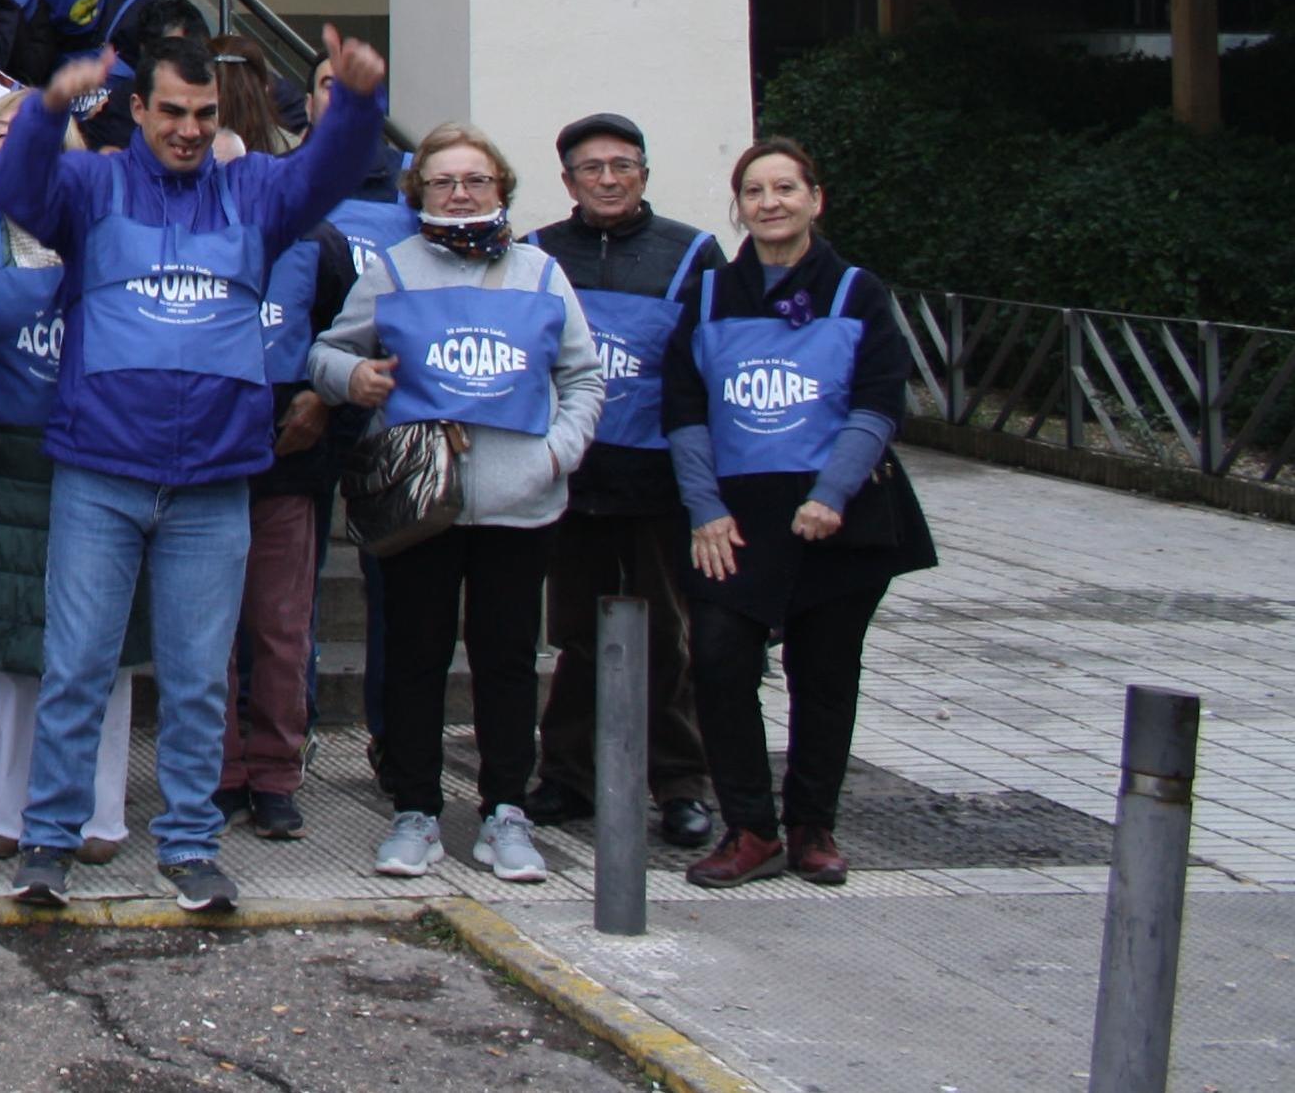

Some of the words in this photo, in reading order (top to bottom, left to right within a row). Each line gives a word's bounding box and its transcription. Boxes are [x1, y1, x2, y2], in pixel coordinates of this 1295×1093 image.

[126, 273, 229, 302] ACOARE
[425, 336, 527, 377] ACOARE
[723, 368, 820, 410] ACOARE
